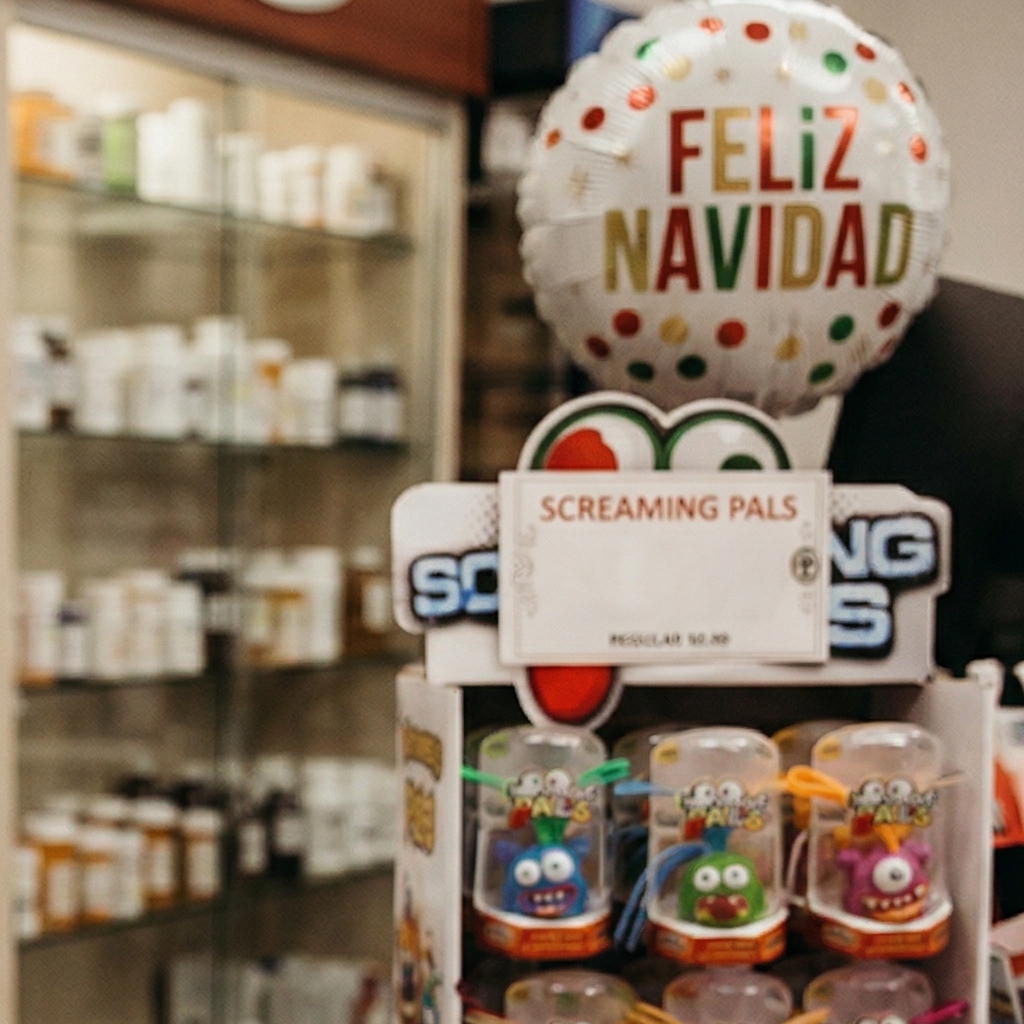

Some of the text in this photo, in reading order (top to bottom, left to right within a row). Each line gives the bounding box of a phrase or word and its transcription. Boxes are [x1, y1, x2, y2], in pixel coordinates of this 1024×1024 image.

[603, 203, 916, 292] NAVIDAD
[539, 495, 798, 522] SCREAMING PALS
